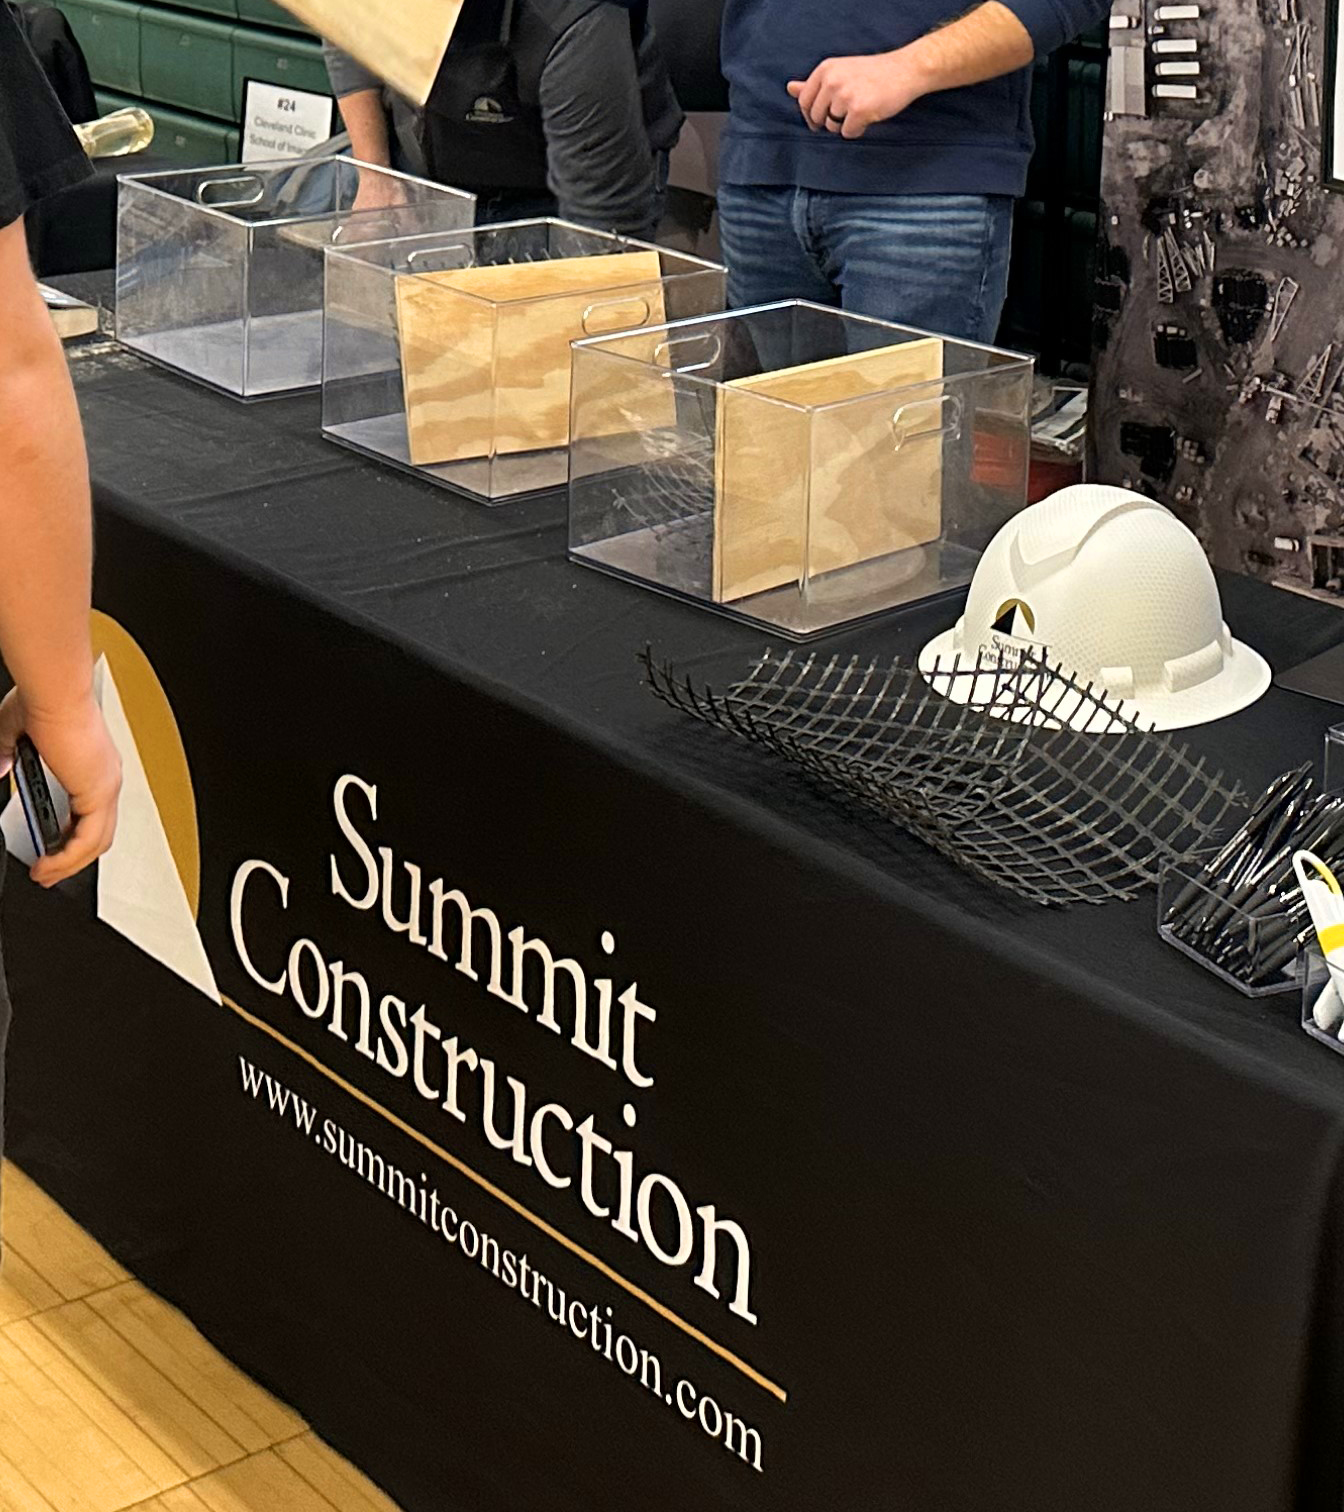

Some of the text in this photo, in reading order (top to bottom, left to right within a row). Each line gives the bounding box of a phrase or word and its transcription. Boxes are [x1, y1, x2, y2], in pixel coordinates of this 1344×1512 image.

[229, 858, 759, 1327] Construction
[330, 773, 657, 1090] Summit
[238, 1055, 765, 1473] www.summitconstruction.com
